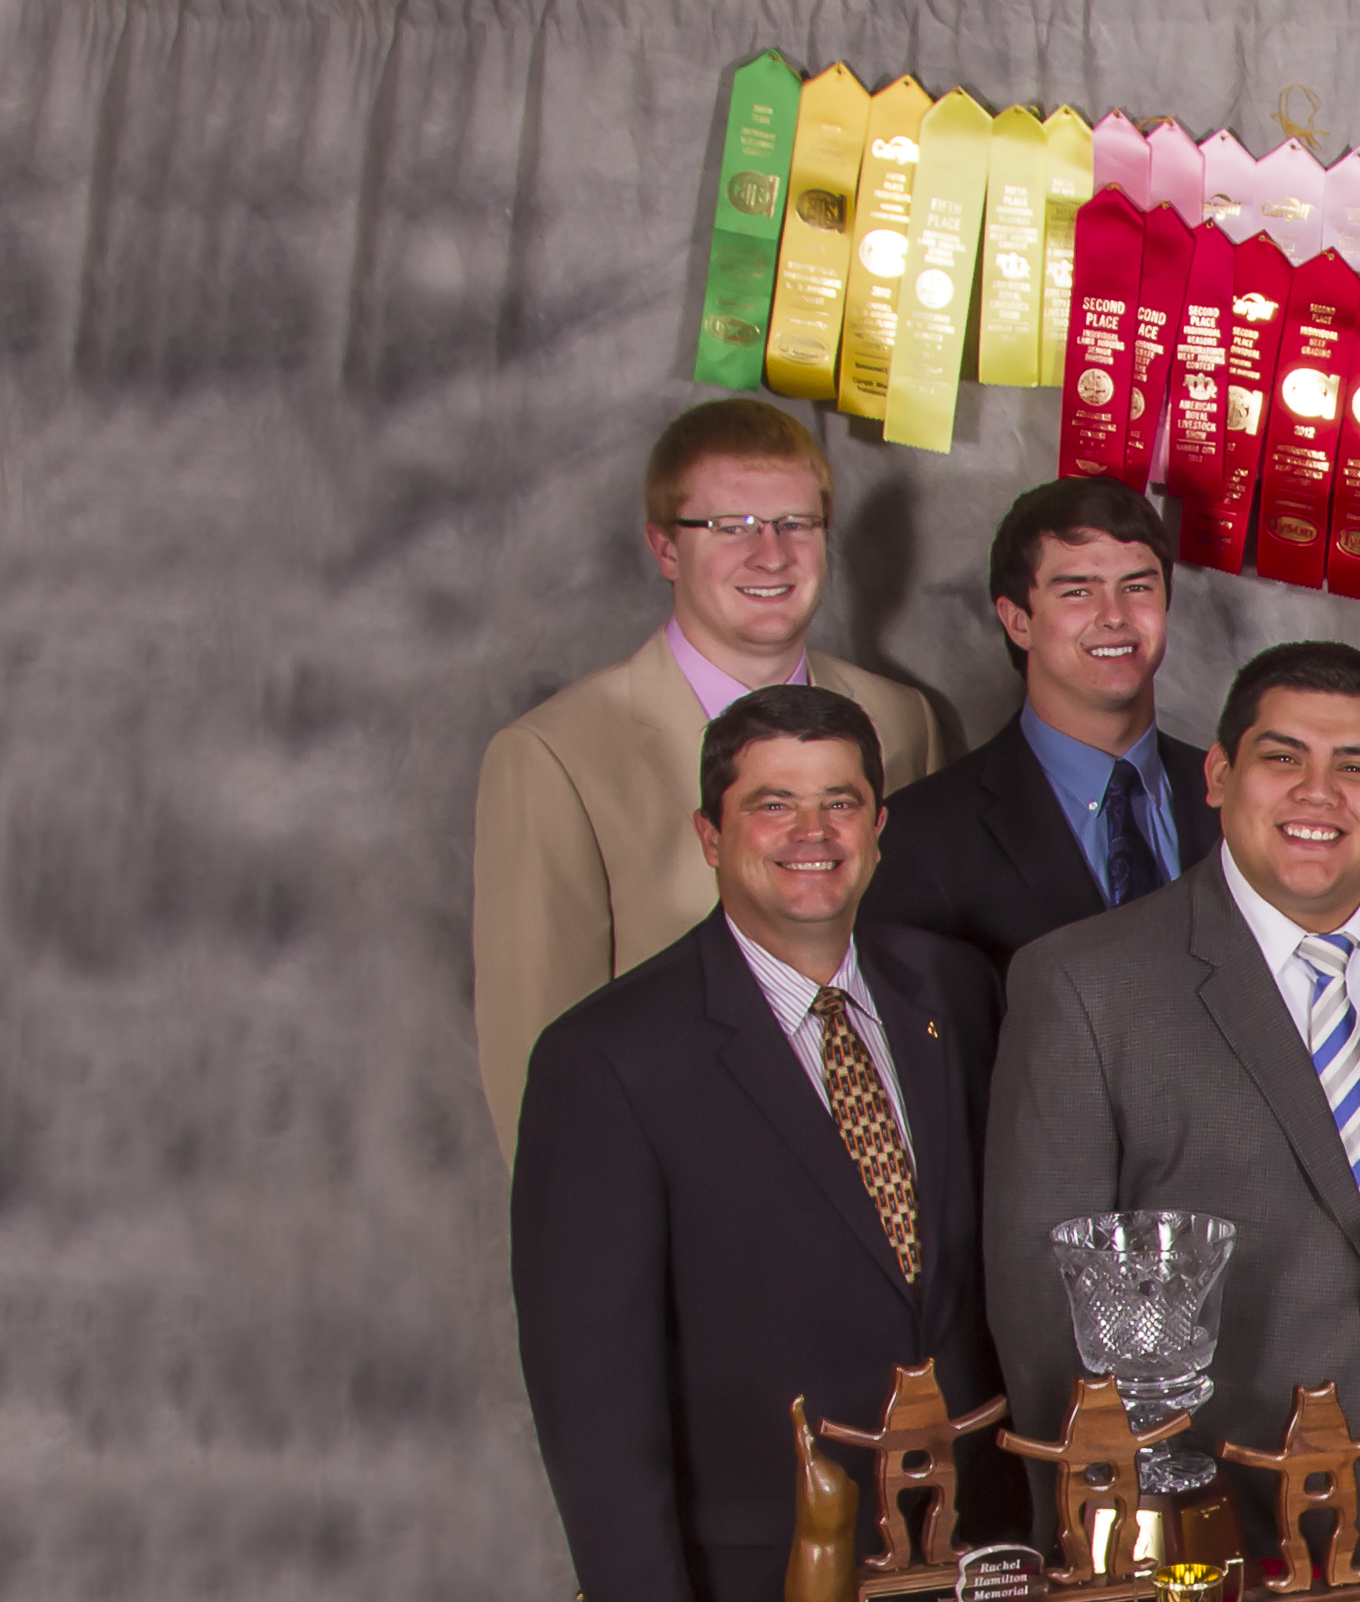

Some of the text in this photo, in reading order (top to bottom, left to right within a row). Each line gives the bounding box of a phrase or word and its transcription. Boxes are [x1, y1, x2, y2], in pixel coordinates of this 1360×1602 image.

[1083, 296, 1125, 314] SECOND
[1188, 305, 1219, 319] SECOND
[1086, 312, 1119, 330] PLACE
[1190, 315, 1217, 328] PLACE
[1180, 400, 1217, 414] AMERICAN
[980, 1559, 1021, 1574] Rachel
[974, 1573, 1027, 1587] Hamilton
[974, 1586, 1029, 1599] Memorial
